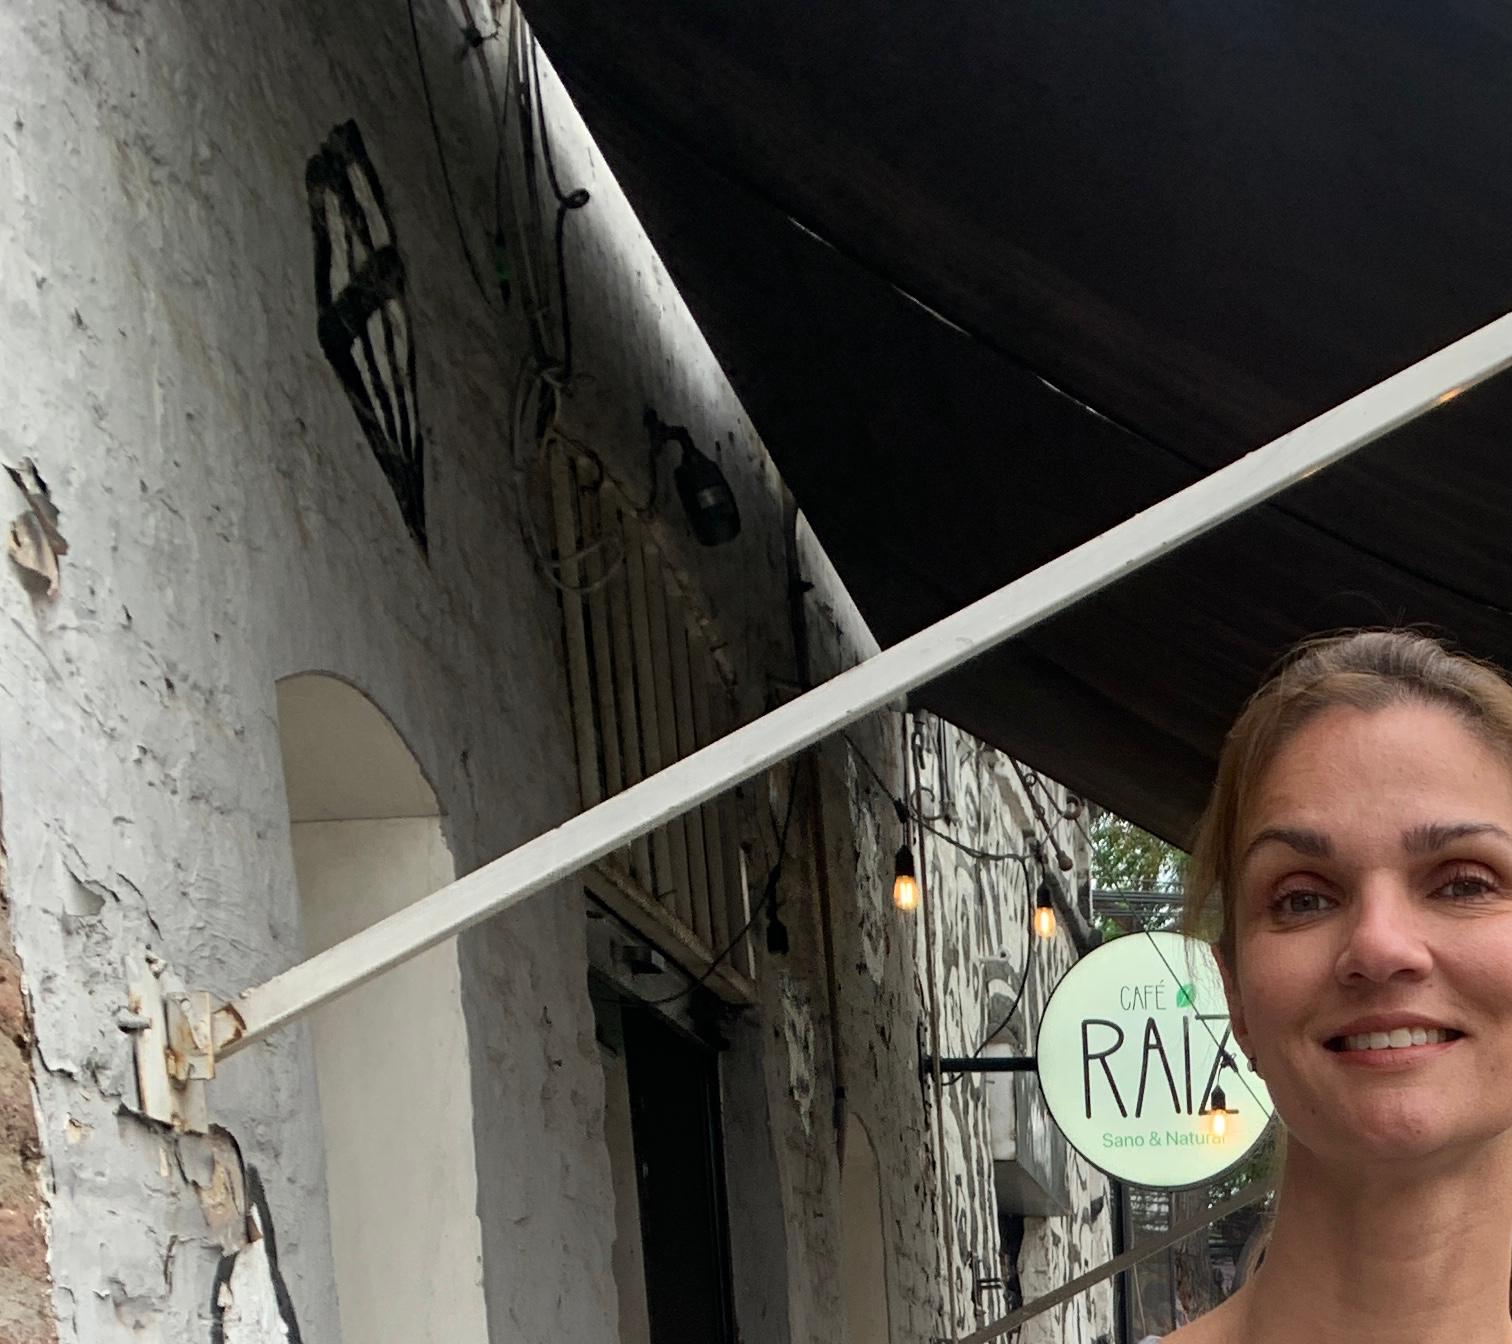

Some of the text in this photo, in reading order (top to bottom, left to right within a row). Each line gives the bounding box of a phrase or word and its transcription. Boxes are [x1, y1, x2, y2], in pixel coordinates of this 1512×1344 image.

[1120, 980, 1167, 1011] CAFÉ
[1081, 1015, 1240, 1119] RAIZ
[1102, 1133, 1145, 1148] Sano
[1149, 1131, 1162, 1147] &
